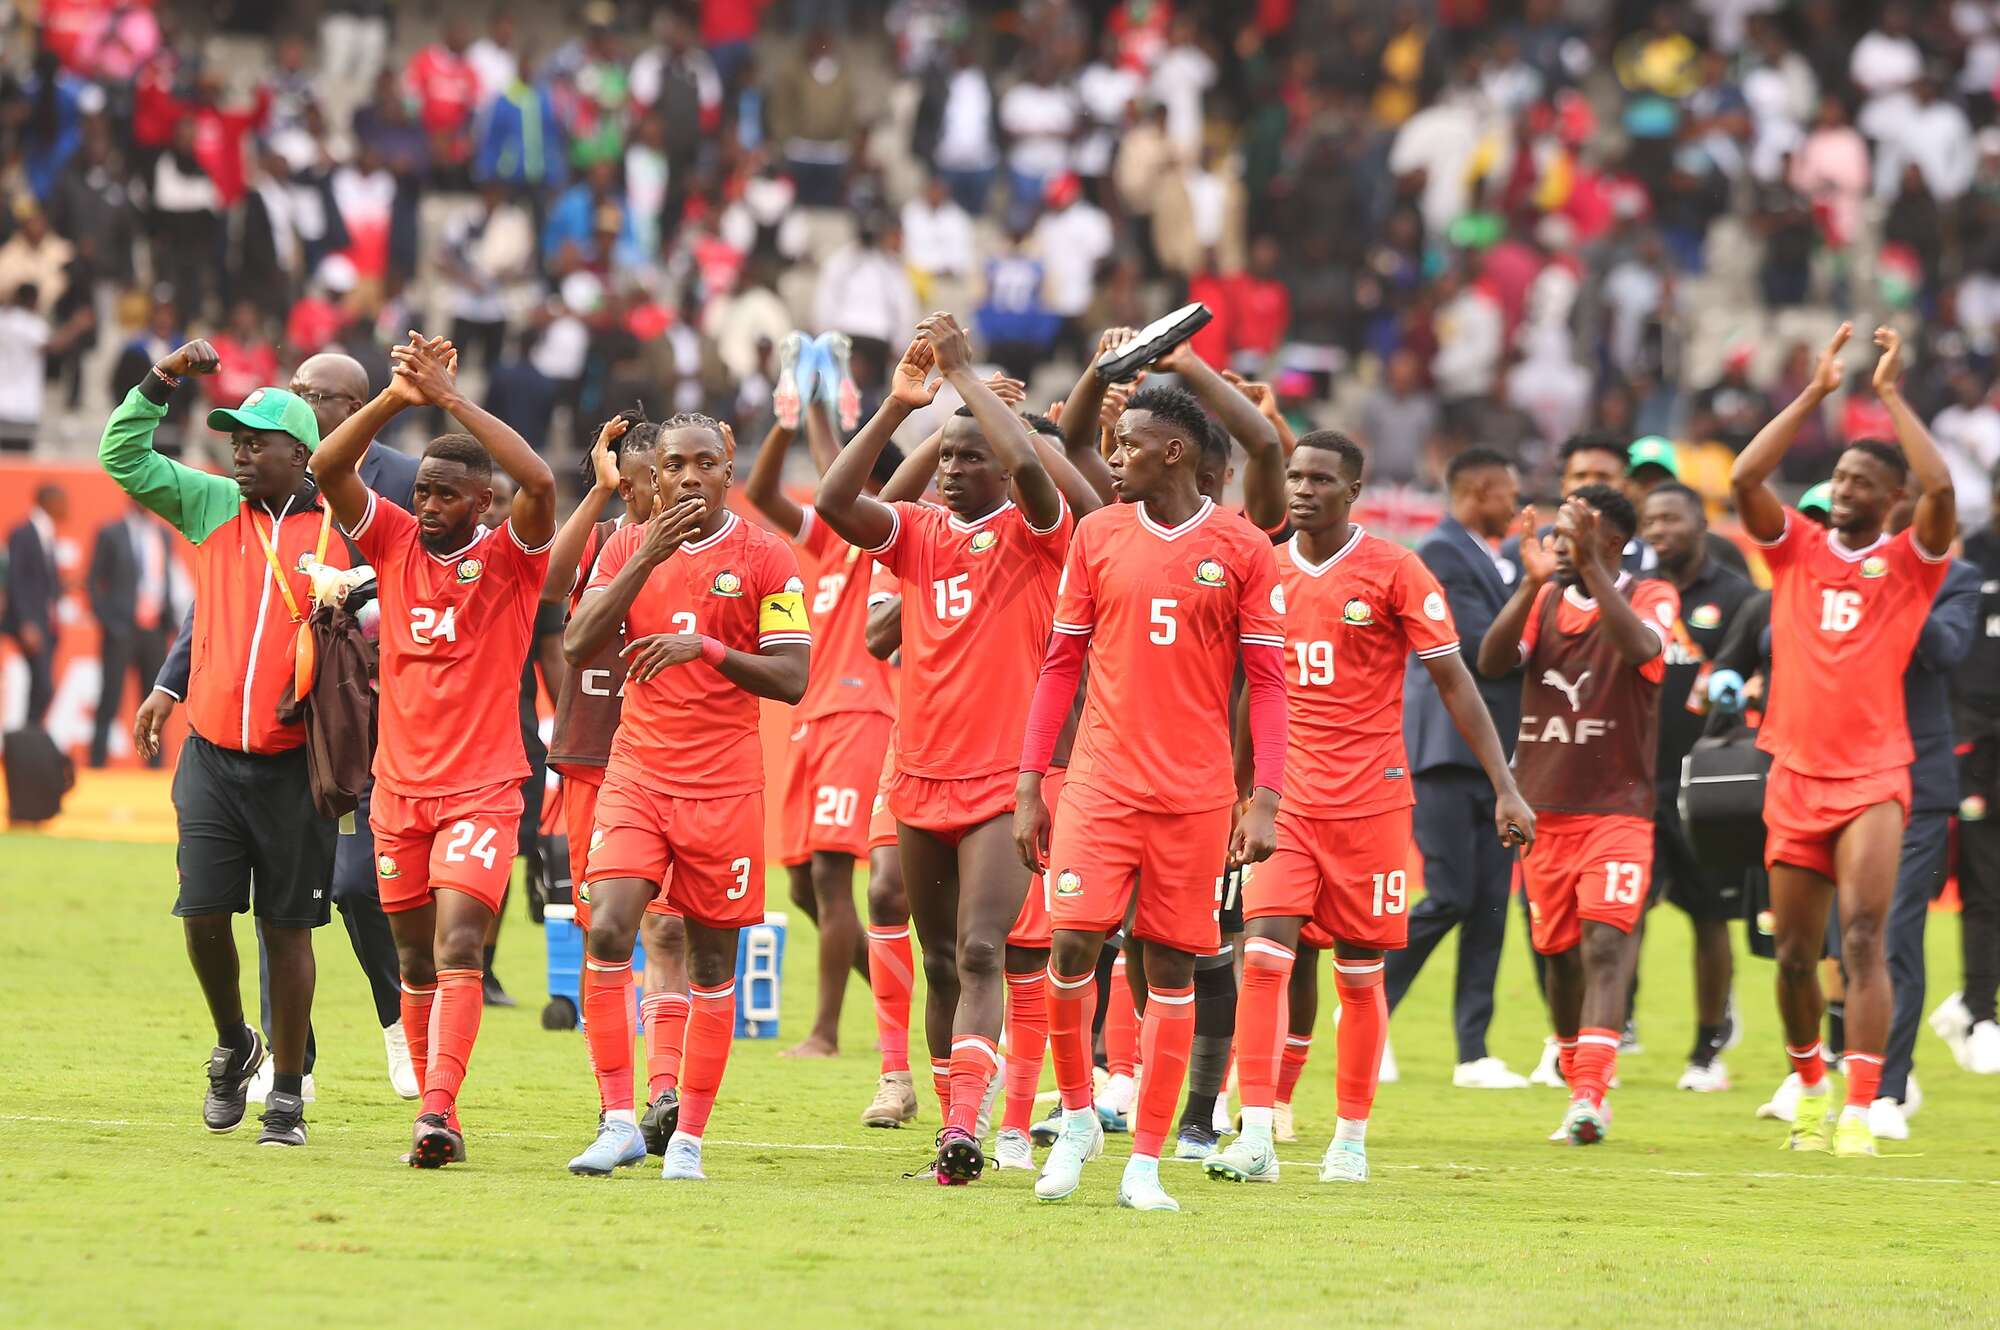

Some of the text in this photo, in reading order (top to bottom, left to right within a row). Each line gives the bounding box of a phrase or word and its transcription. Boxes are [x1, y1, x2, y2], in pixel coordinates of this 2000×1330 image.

[932, 573, 973, 619] 15
[1820, 588, 1862, 631] 16
[410, 606, 456, 644] 24
[1149, 598, 1178, 645] 5
[1294, 641, 1335, 686] 19
[814, 786, 858, 826] 20
[445, 821, 498, 870] 24
[727, 857, 751, 900] 3
[1372, 870, 1406, 916] 19
[1604, 861, 1642, 904] 13
